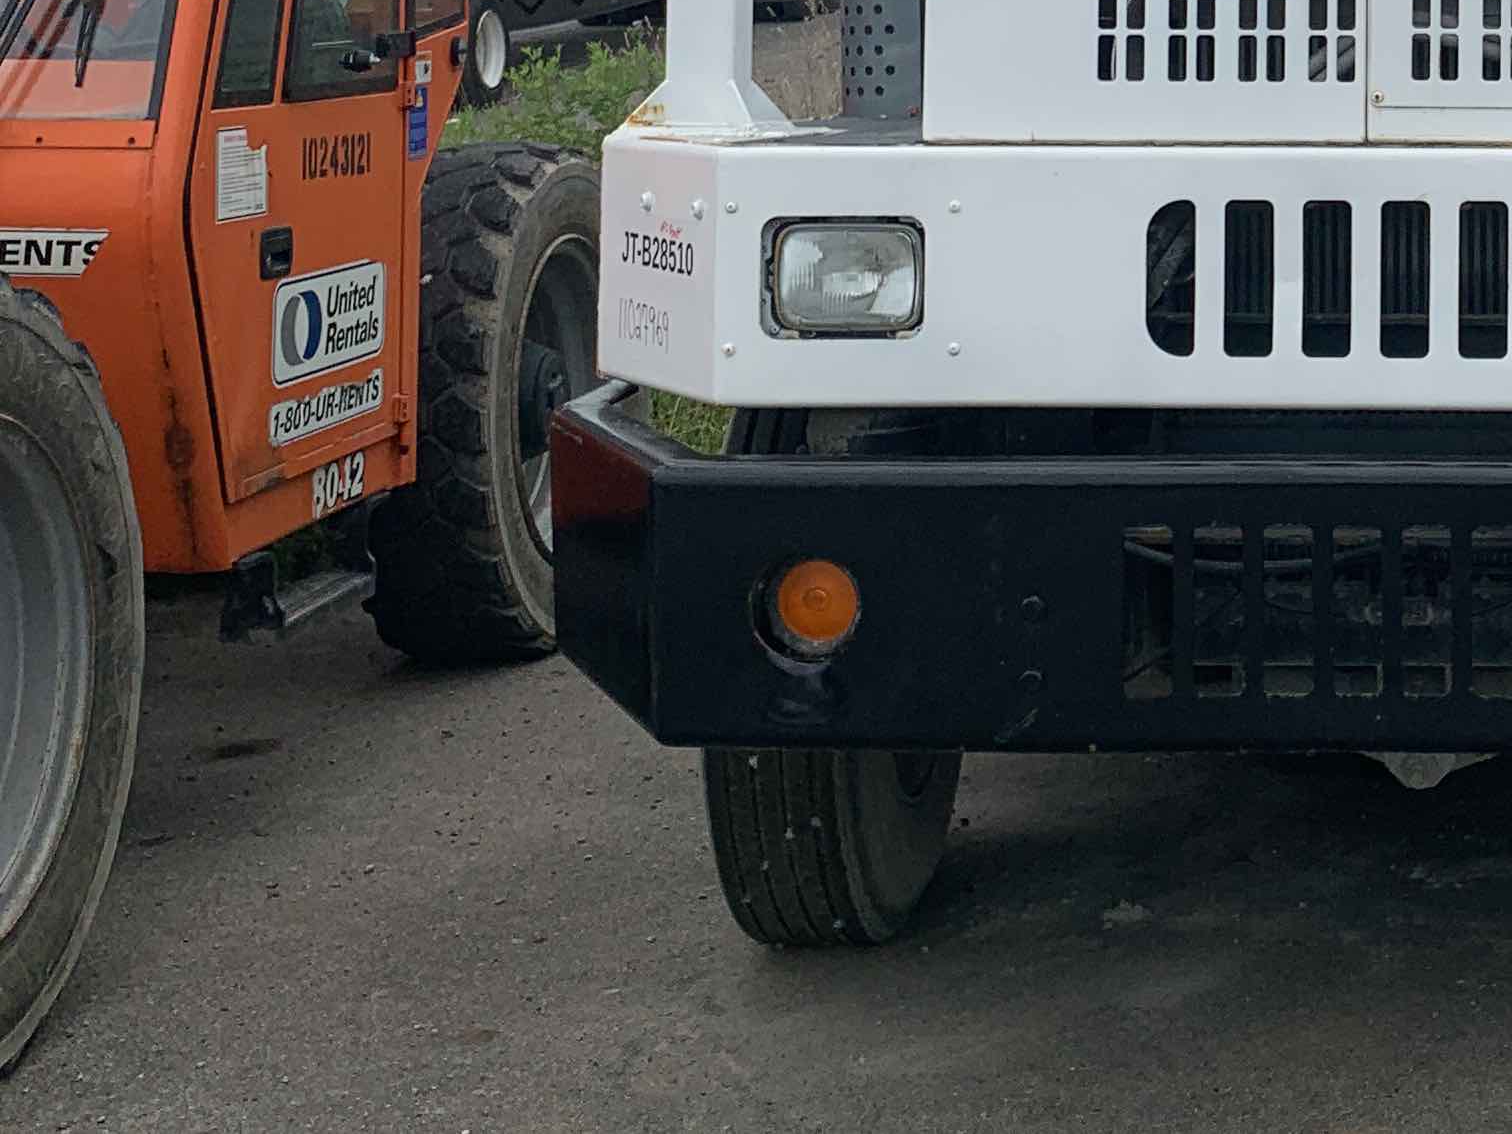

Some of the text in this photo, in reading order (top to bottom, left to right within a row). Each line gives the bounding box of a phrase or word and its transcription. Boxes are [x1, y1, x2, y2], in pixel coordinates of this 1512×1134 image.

[302, 132, 371, 180] 10243121
[327, 275, 377, 317] United
[325, 312, 379, 355] Rentals
